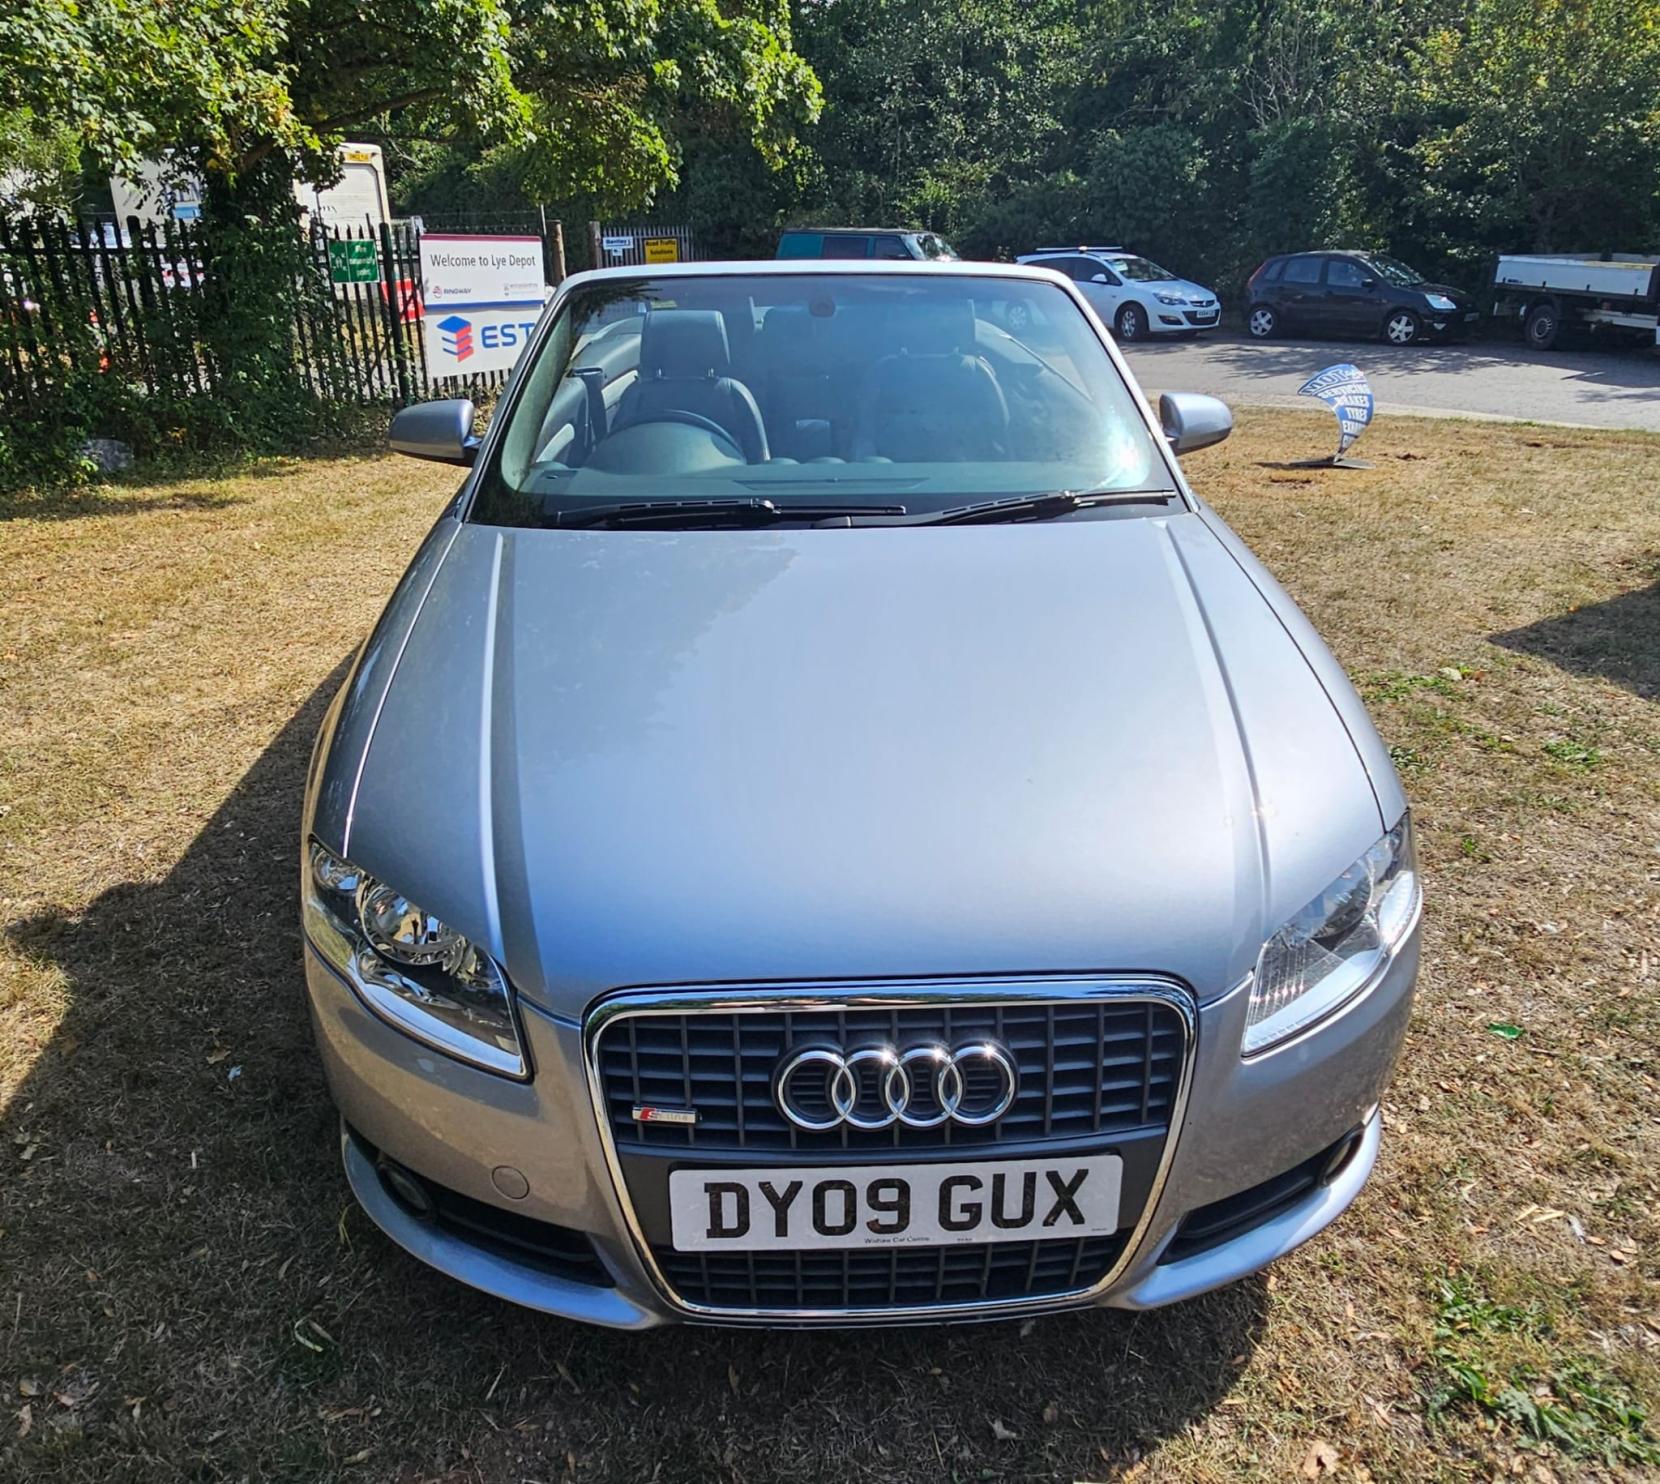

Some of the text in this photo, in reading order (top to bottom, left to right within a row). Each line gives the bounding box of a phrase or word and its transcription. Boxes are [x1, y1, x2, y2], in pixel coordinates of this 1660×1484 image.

[430, 254, 536, 270] Welcome to Lye Depot
[704, 1168, 1089, 1239] DY09 GUX
